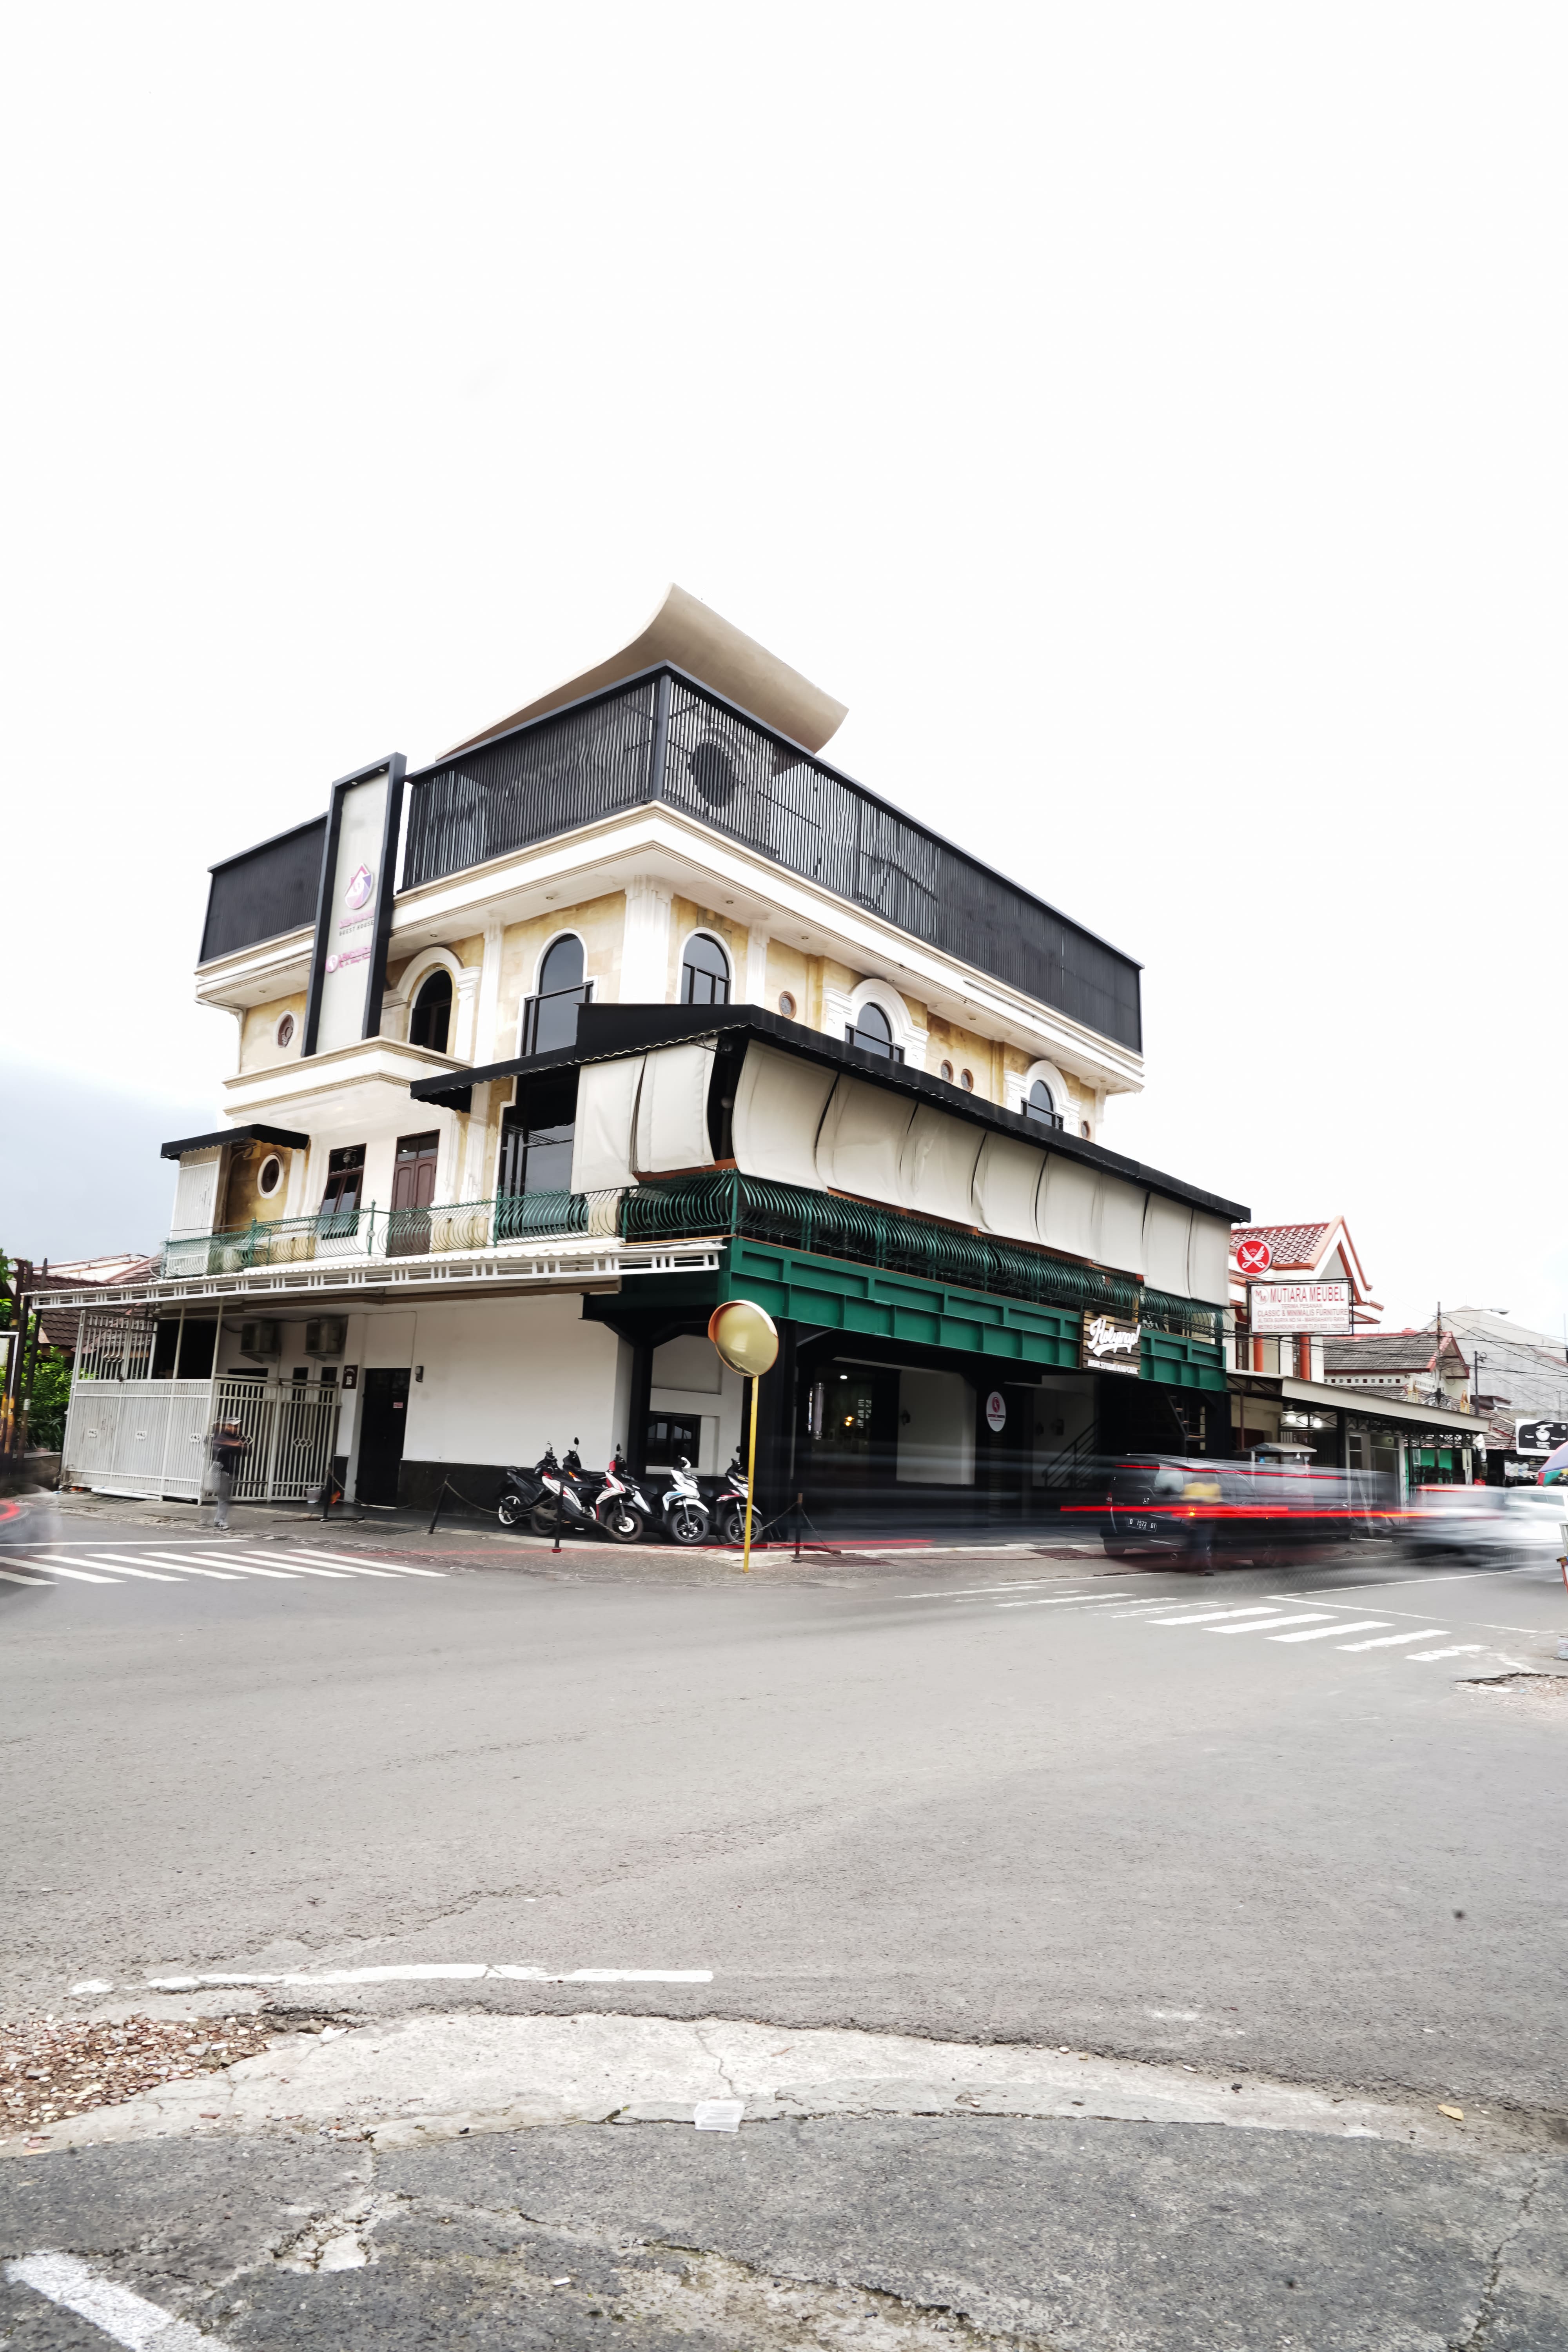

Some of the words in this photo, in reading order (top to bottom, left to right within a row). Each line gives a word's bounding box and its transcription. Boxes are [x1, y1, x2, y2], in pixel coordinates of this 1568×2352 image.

[357, 920, 374, 930] HOUSE
[1270, 1287, 1307, 1303] MUTIARA
[1310, 1286, 1344, 1301] MEUBEL
